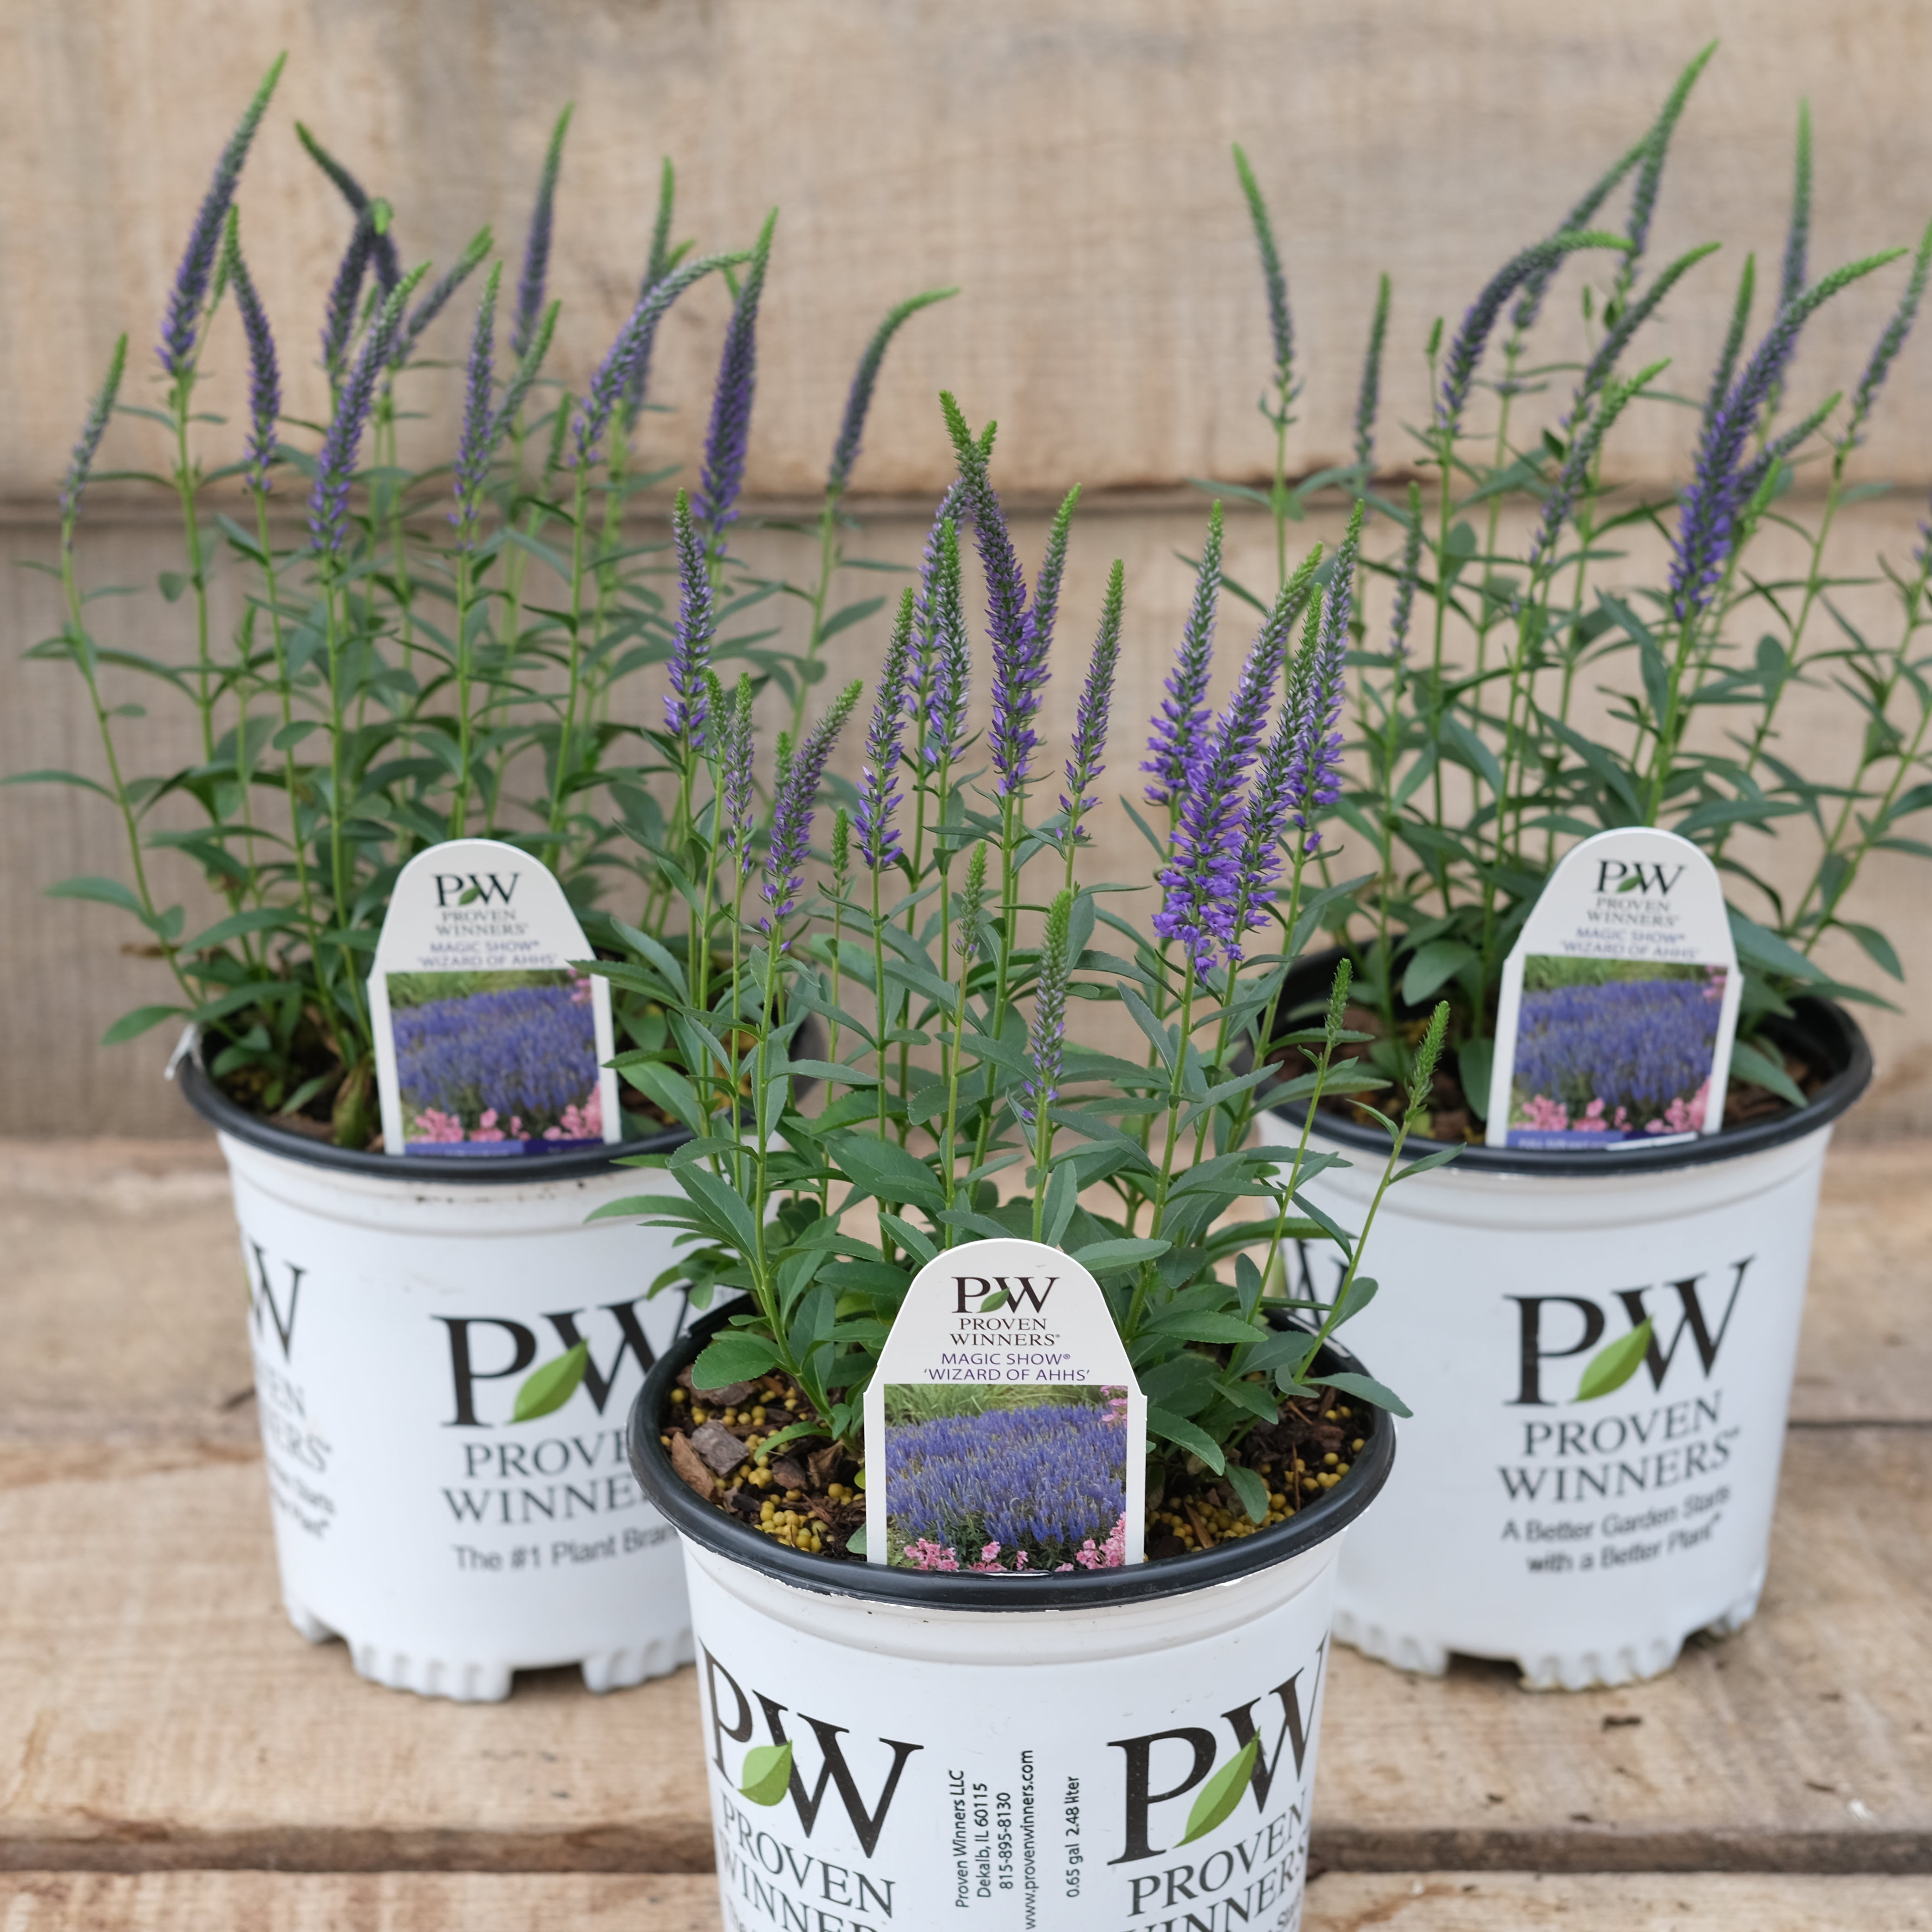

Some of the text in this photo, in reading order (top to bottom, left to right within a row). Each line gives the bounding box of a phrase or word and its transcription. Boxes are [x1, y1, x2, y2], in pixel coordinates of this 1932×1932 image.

[432, 872, 520, 907] PW
[1593, 858, 1688, 896] PW
[442, 909, 516, 922] PROVEN
[1596, 897, 1670, 912] PROVEN
[951, 1277, 1060, 1314] PW
[959, 1318, 1047, 1330] PROVEN
[1501, 1253, 1757, 1408] PW
[942, 1353, 1000, 1364] MAGIC
[1006, 1369, 1030, 1381] OF
[1522, 1389, 1722, 1457] PROVEN
[464, 1429, 627, 1478] PROVE
[442, 1472, 651, 1524] WINNE
[451, 1523, 678, 1571] The #1 Plant Bran
[1501, 1519, 1520, 1542] A
[1525, 1518, 1594, 1543] Better
[1601, 1505, 1677, 1538] Garden
[1527, 1553, 1573, 1573] with
[1580, 1555, 1593, 1570] a
[1600, 1540, 1661, 1568] Better
[698, 1635, 924, 1859] PW
[1106, 1629, 1328, 1866] PW
[721, 1788, 896, 1918] PROVEN
[948, 1769, 969, 1908] Proven Winners LLC
[973, 1783, 992, 1898] Dekalb, IL 60115
[996, 1792, 1013, 1889] 815-895-8130
[1020, 1750, 1039, 1930] www.provenwinners.com
[1064, 1776, 1083, 1898] 0.65 gal 2.48 liter
[1127, 1786, 1306, 1918] PROVEN
